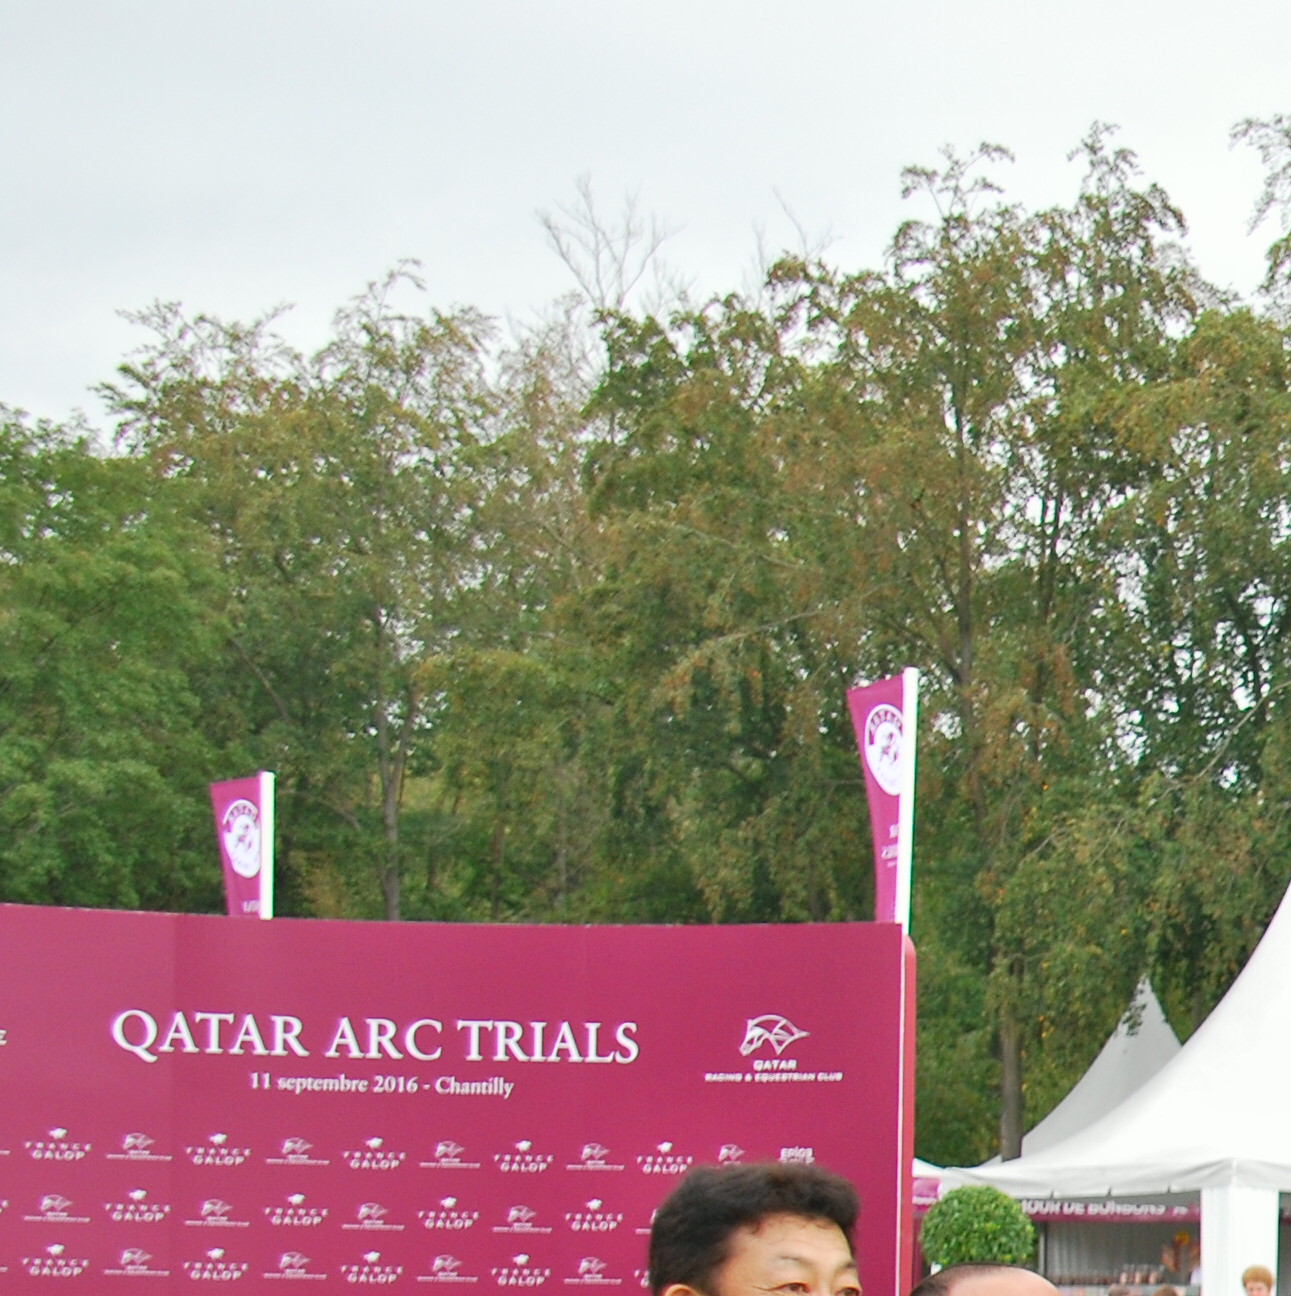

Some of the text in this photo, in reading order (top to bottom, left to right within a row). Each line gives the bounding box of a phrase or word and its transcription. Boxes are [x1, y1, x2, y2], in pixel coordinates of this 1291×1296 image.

[111, 1010, 639, 1064] QATAR ARC TRIALS
[753, 1060, 797, 1071] QATAR
[250, 1072, 271, 1090] 11
[278, 1074, 367, 1095] septembre
[373, 1076, 418, 1093] 2016
[435, 1077, 514, 1099] Chantilly
